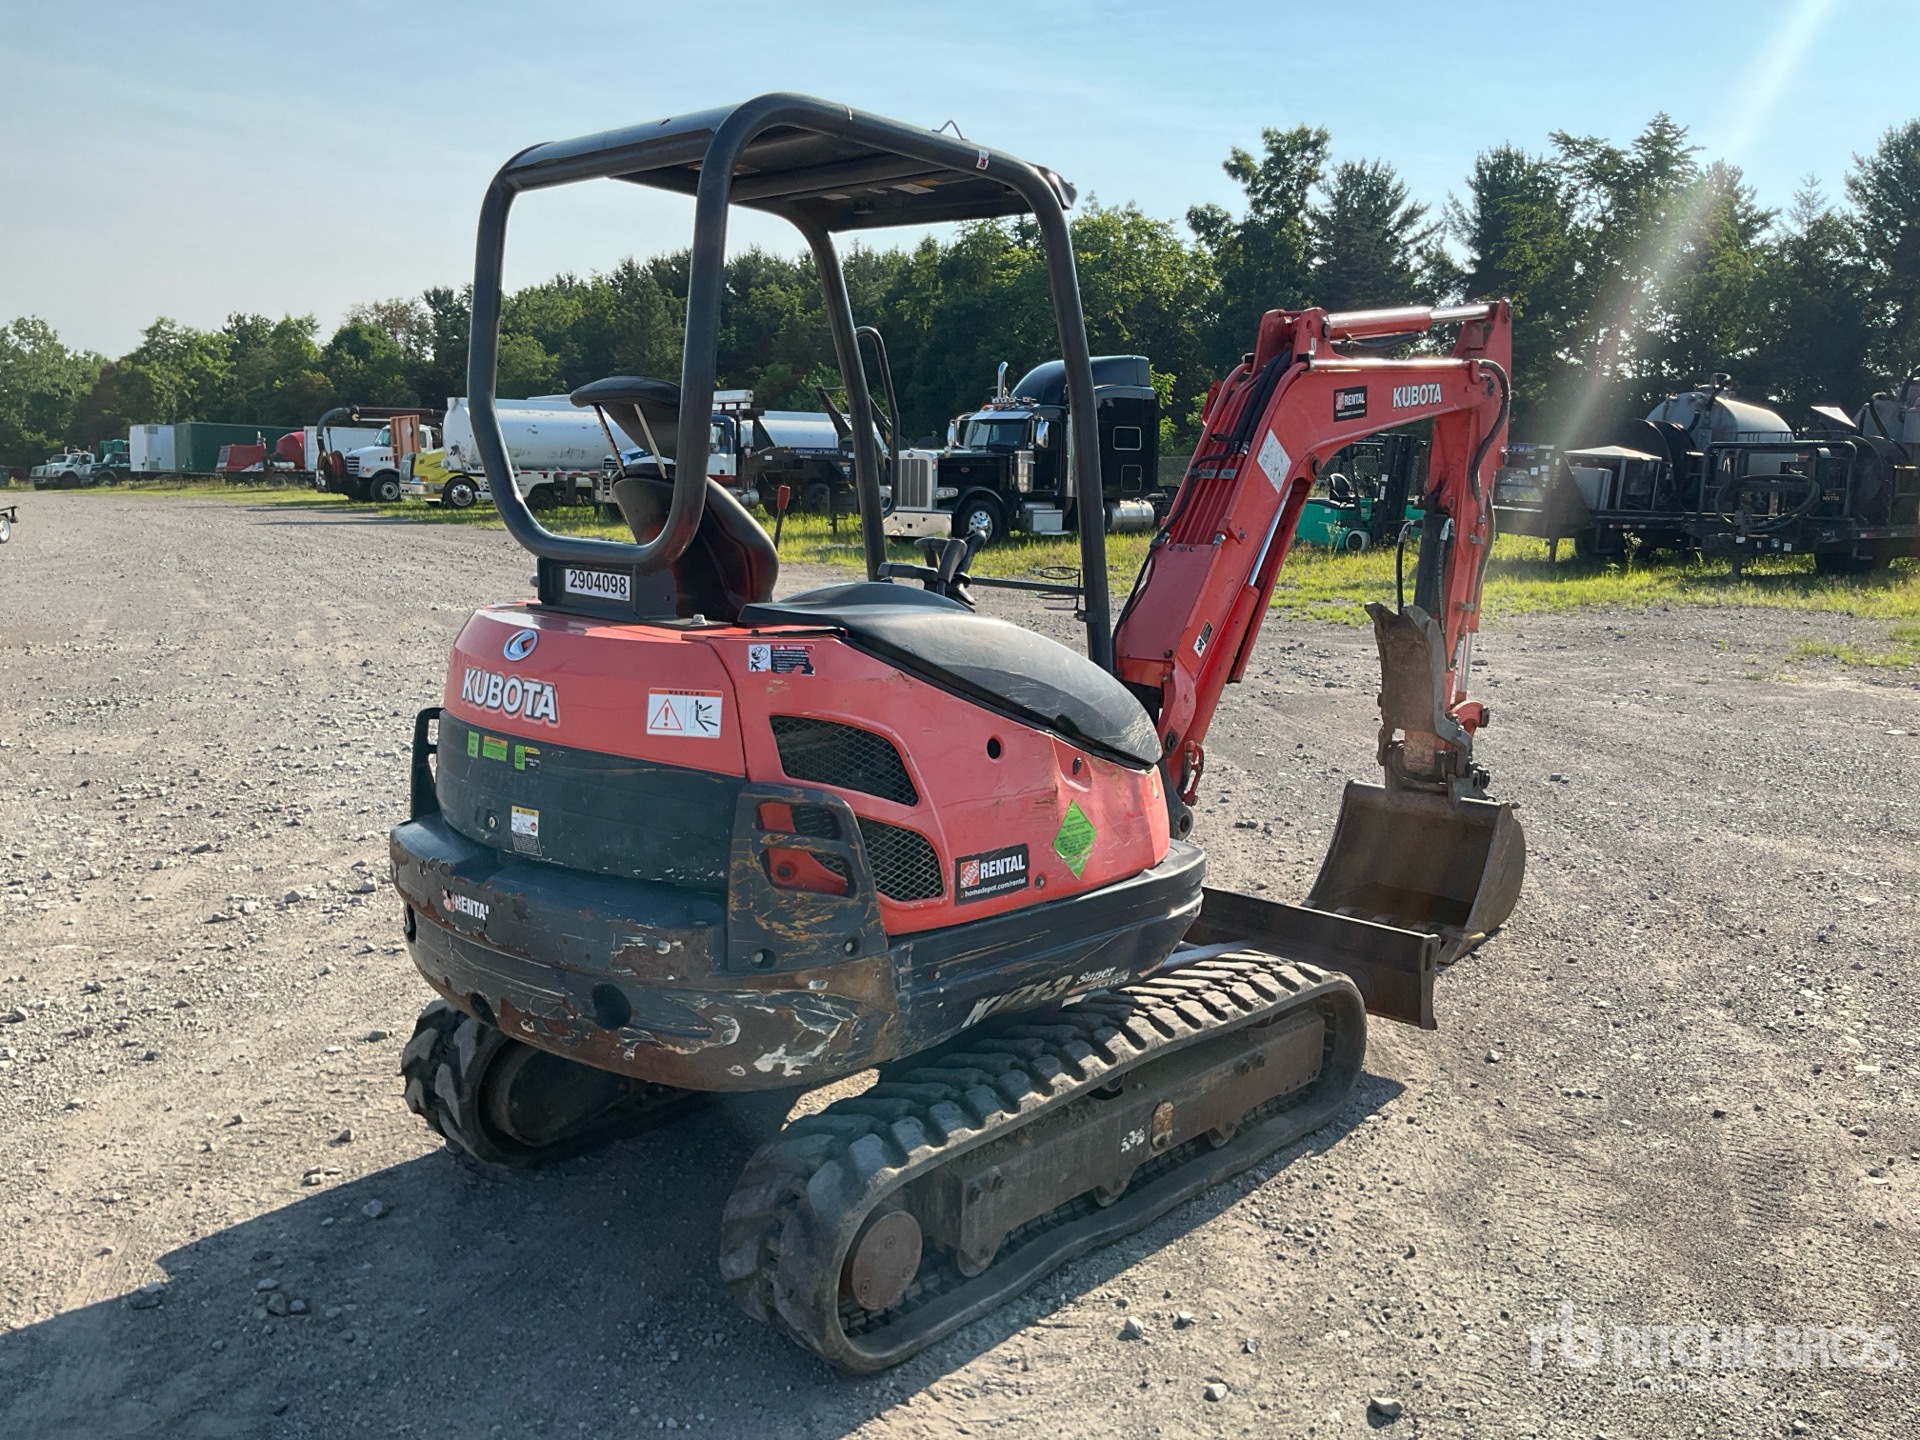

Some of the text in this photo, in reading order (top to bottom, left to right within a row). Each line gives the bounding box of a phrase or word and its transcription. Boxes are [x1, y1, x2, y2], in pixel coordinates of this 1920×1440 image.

[1344, 392, 1366, 407] RENTAL
[1392, 383, 1442, 409] KUBOTA
[570, 570, 627, 595] 2904098
[461, 667, 558, 724] KUBOTA
[980, 853, 1026, 879] RENTAL
[964, 876, 1026, 898] homedepot.com/rental
